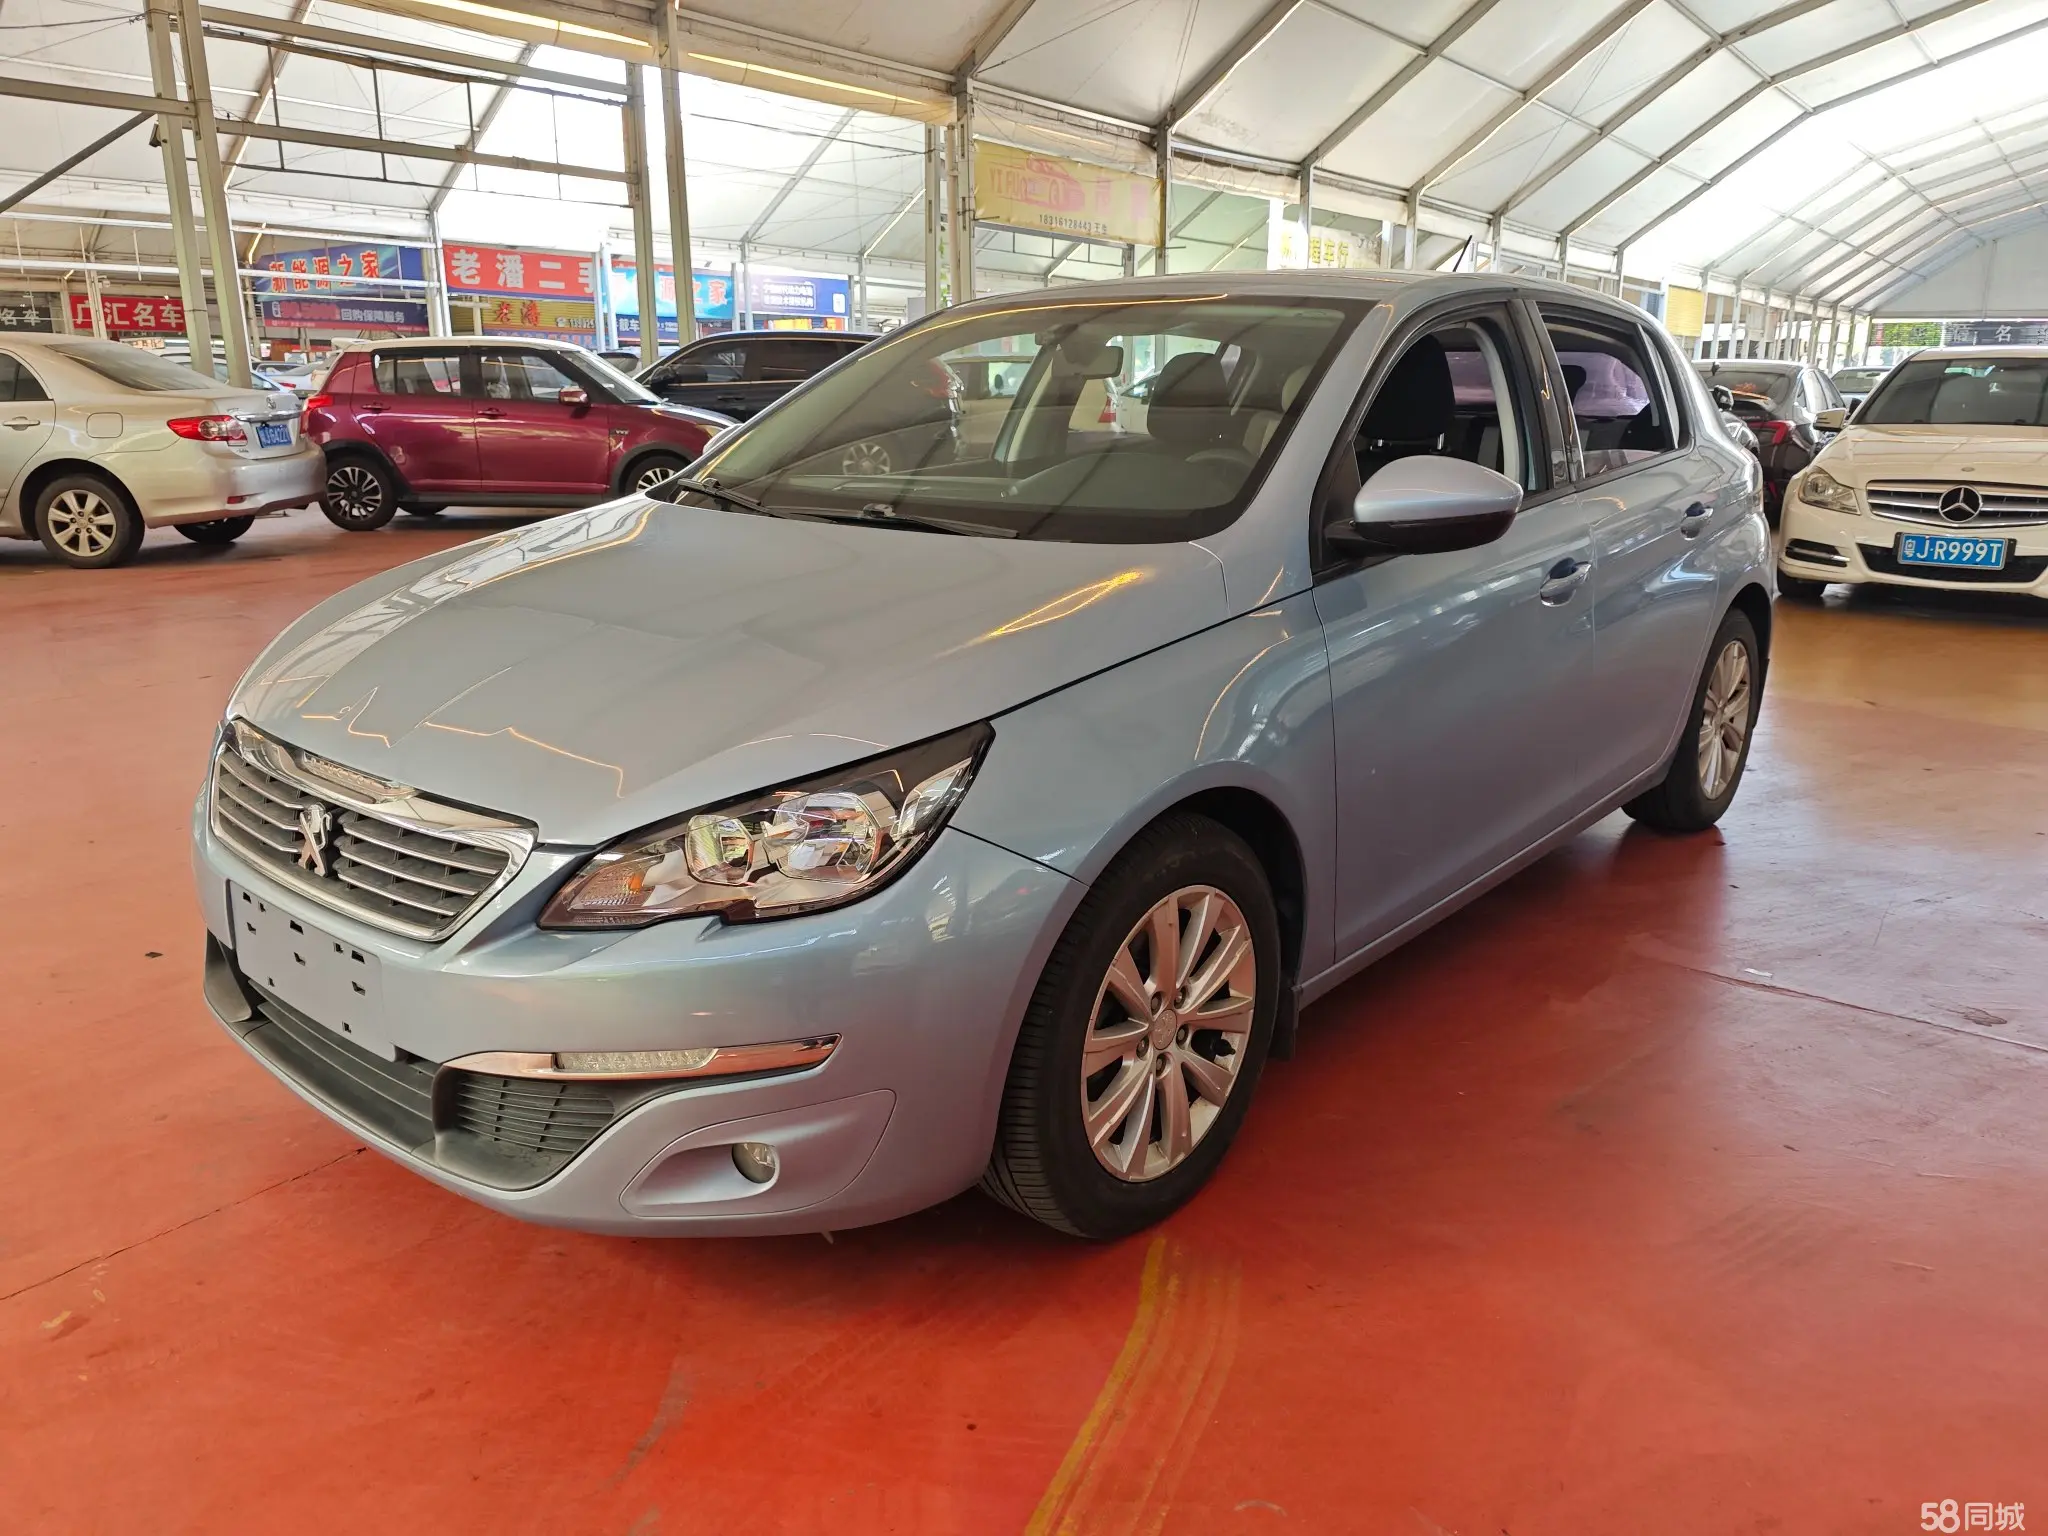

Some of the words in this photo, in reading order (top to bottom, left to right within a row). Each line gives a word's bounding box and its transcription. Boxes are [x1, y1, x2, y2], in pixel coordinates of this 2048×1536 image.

[269, 250, 380, 293] 新能源之家
[76, 301, 184, 328] 广汇名车
